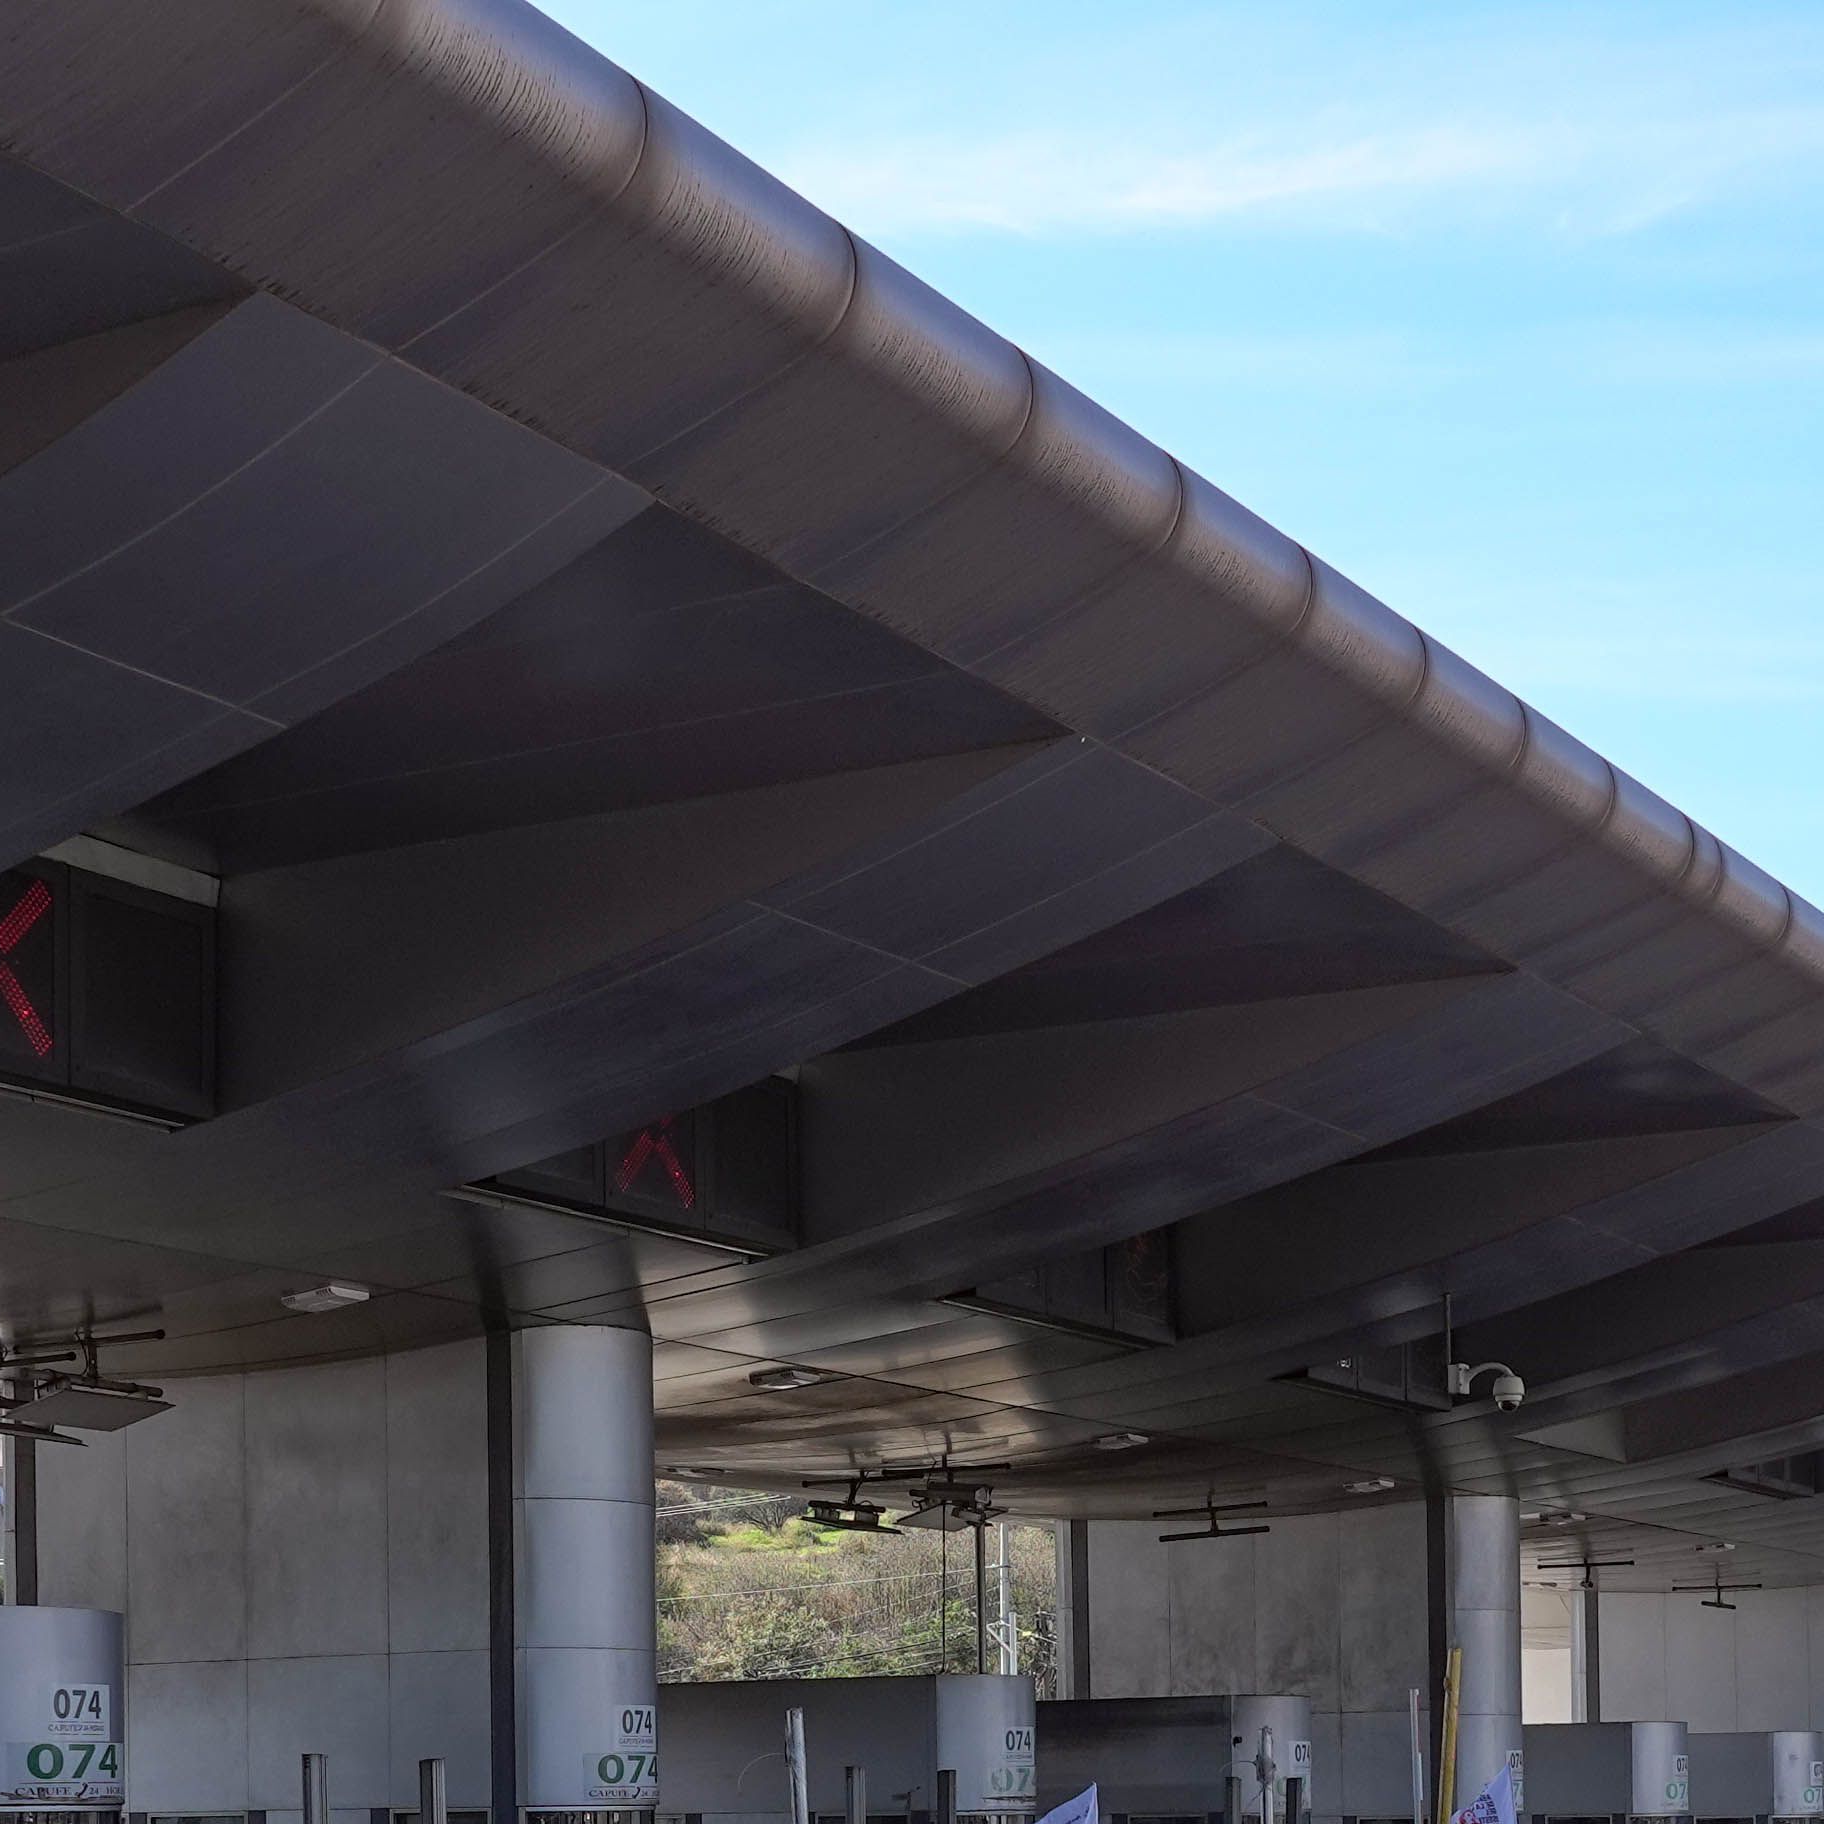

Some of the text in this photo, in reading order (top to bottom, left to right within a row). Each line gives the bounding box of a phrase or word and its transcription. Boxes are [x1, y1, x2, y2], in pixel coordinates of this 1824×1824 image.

[53, 1688, 102, 1720] 074
[622, 1709, 652, 1735] 074
[1005, 1730, 1031, 1751] 074
[26, 1743, 118, 1780] 074
[597, 1754, 658, 1785] 074
